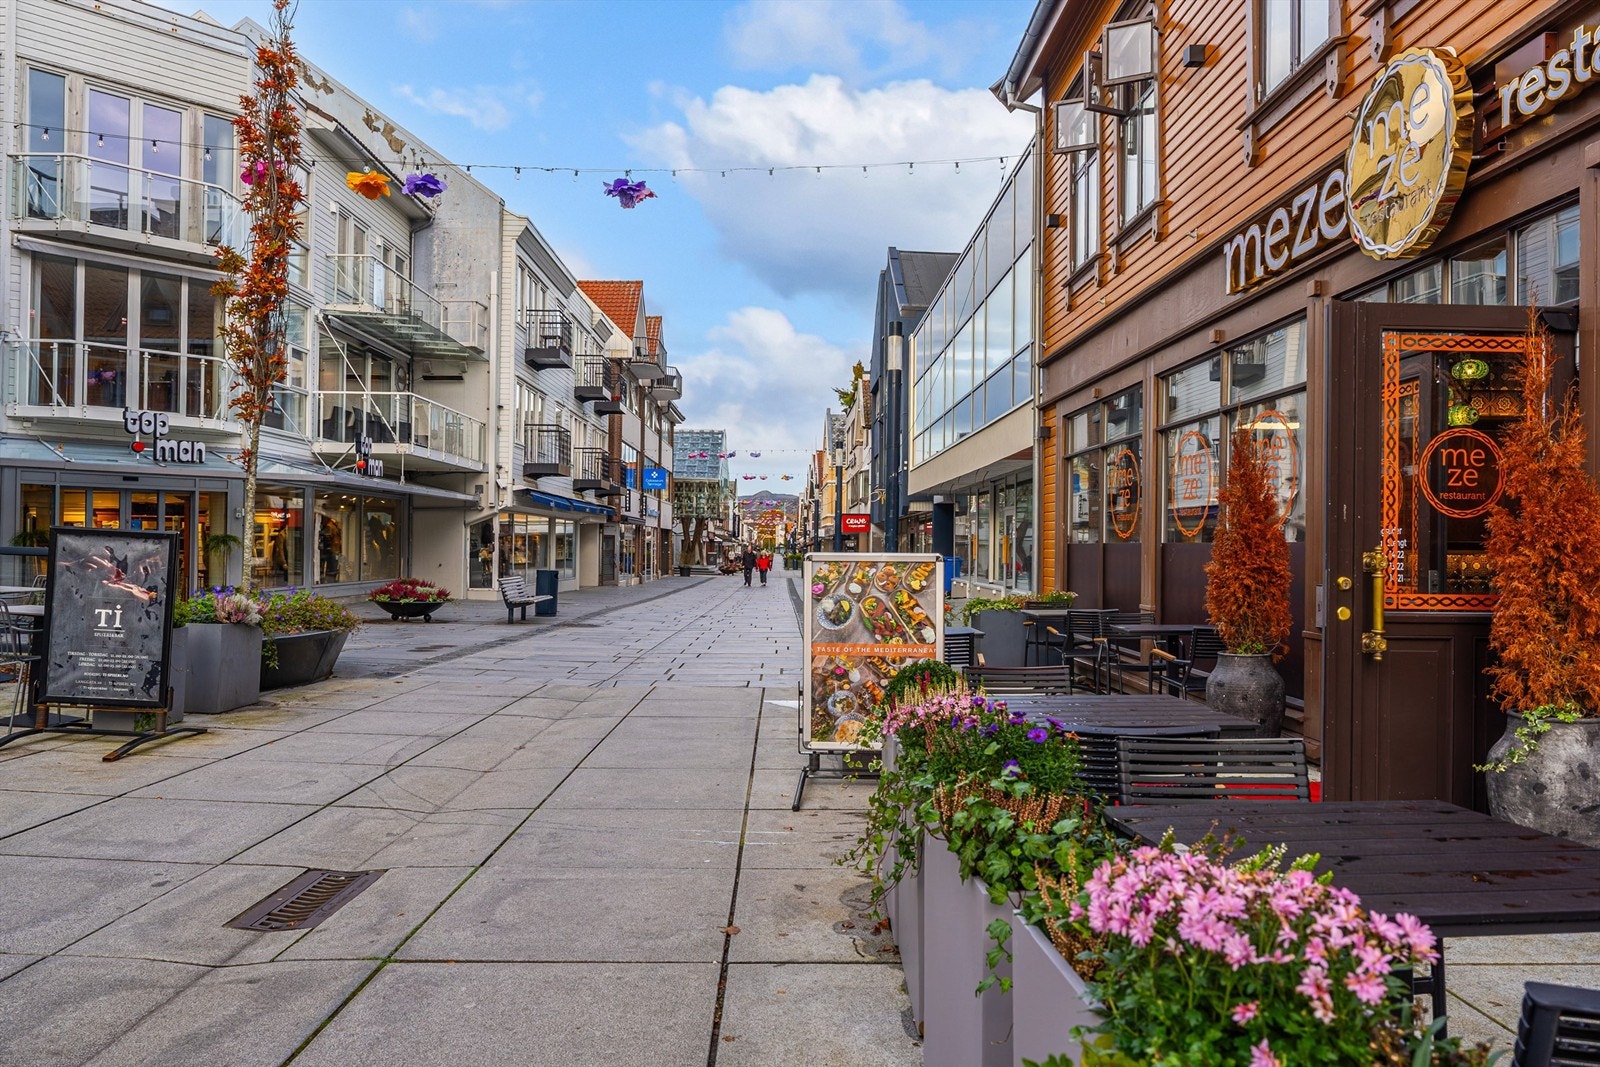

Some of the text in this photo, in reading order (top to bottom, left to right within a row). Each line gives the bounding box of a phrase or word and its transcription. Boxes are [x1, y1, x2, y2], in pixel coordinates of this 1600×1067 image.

[1366, 82, 1431, 159] me
[1377, 141, 1421, 202] ze
[1360, 179, 1434, 227] restaurant
[1223, 168, 1348, 296] meze
[123, 407, 169, 439] top
[154, 439, 206, 463] man
[1440, 448, 1486, 467] me
[1180, 452, 1203, 476] me
[1117, 467, 1133, 487] me
[1183, 478, 1199, 500] ze
[1447, 468, 1479, 487] ze
[1439, 491, 1486, 500] restaurant
[94, 604, 123, 628] Ti
